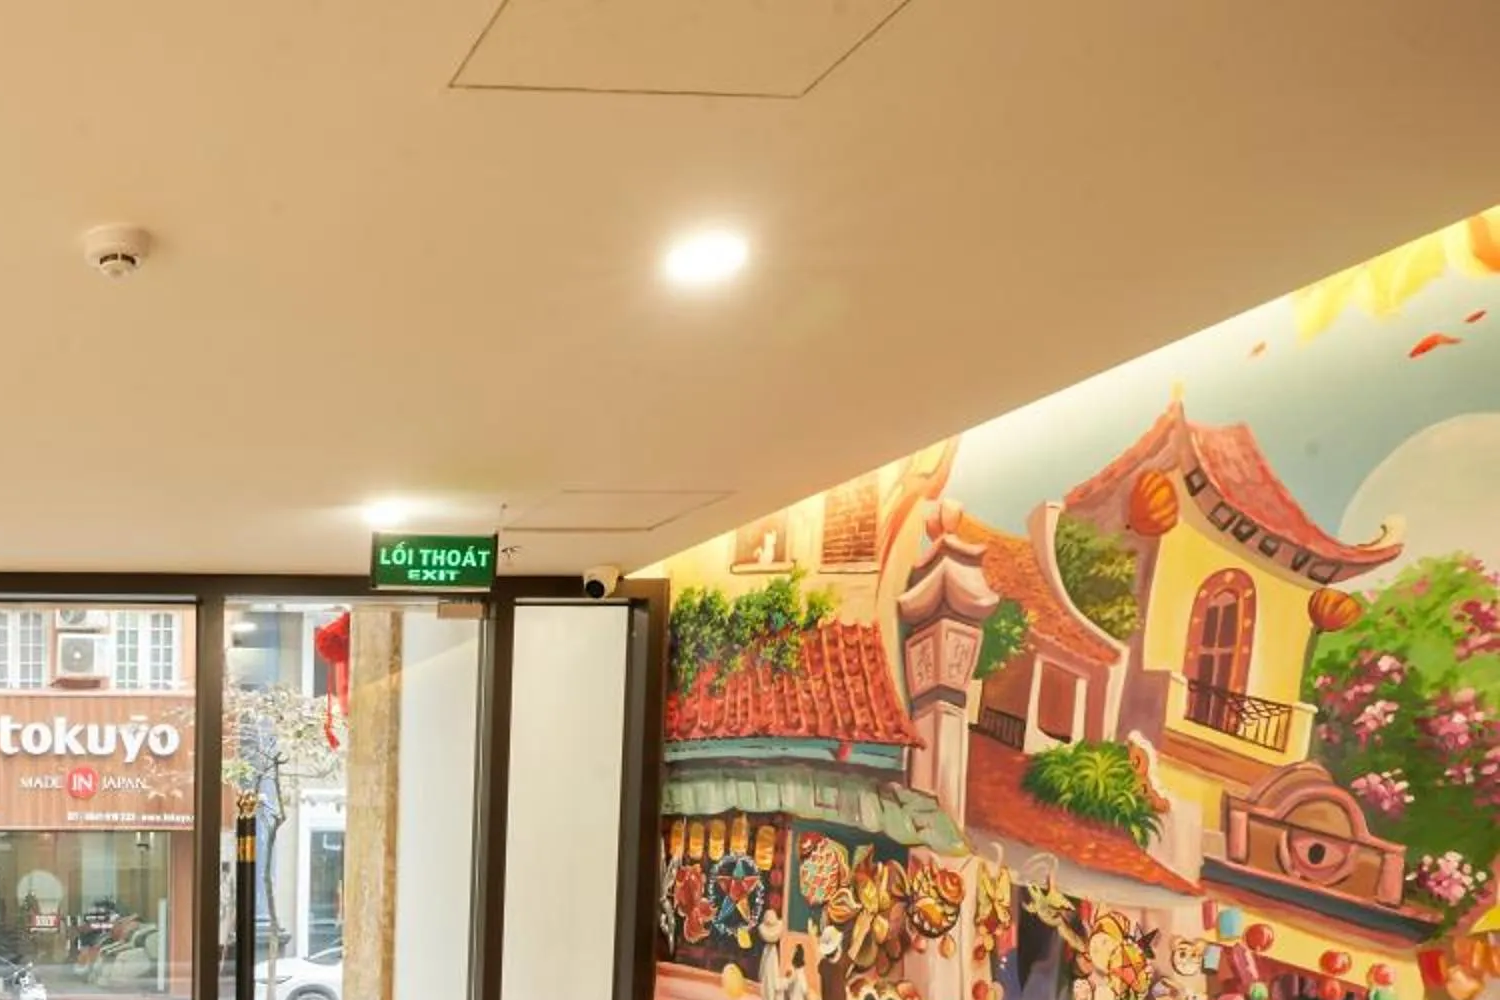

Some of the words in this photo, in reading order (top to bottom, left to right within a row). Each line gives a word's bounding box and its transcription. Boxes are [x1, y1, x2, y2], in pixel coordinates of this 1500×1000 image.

[380, 541, 414, 566] LỐI
[419, 545, 491, 568] THOÁT
[407, 569, 460, 581] EXIT
[19, 776, 64, 789] MADE
[72, 774, 94, 792] IN
[102, 775, 148, 790] JAPAN
